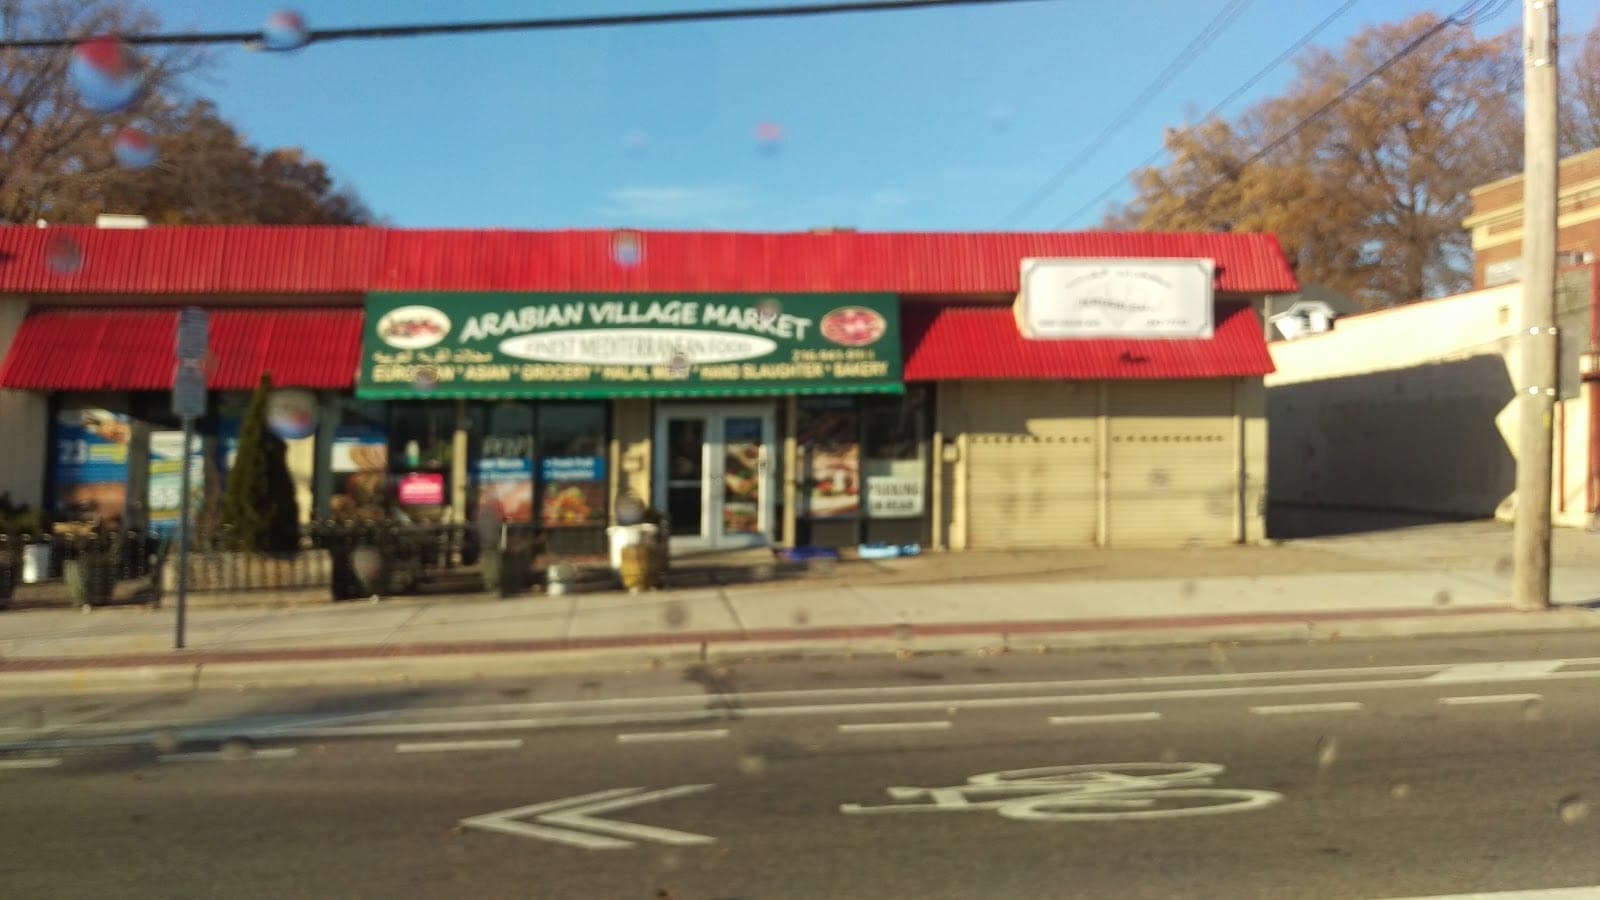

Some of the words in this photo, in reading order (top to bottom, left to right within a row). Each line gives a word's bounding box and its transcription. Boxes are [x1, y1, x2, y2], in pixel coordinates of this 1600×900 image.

[459, 302, 584, 343] ARABIAN
[588, 300, 699, 326] VILLAGE
[702, 302, 812, 341] MARKET
[372, 364, 455, 382] EUROAN
[463, 364, 511, 381] ASIAN
[520, 363, 591, 381] GROCERY
[602, 363, 650, 381] HALAL
[742, 361, 825, 379] SLAUGHTER
[832, 360, 888, 379] BAKERY
